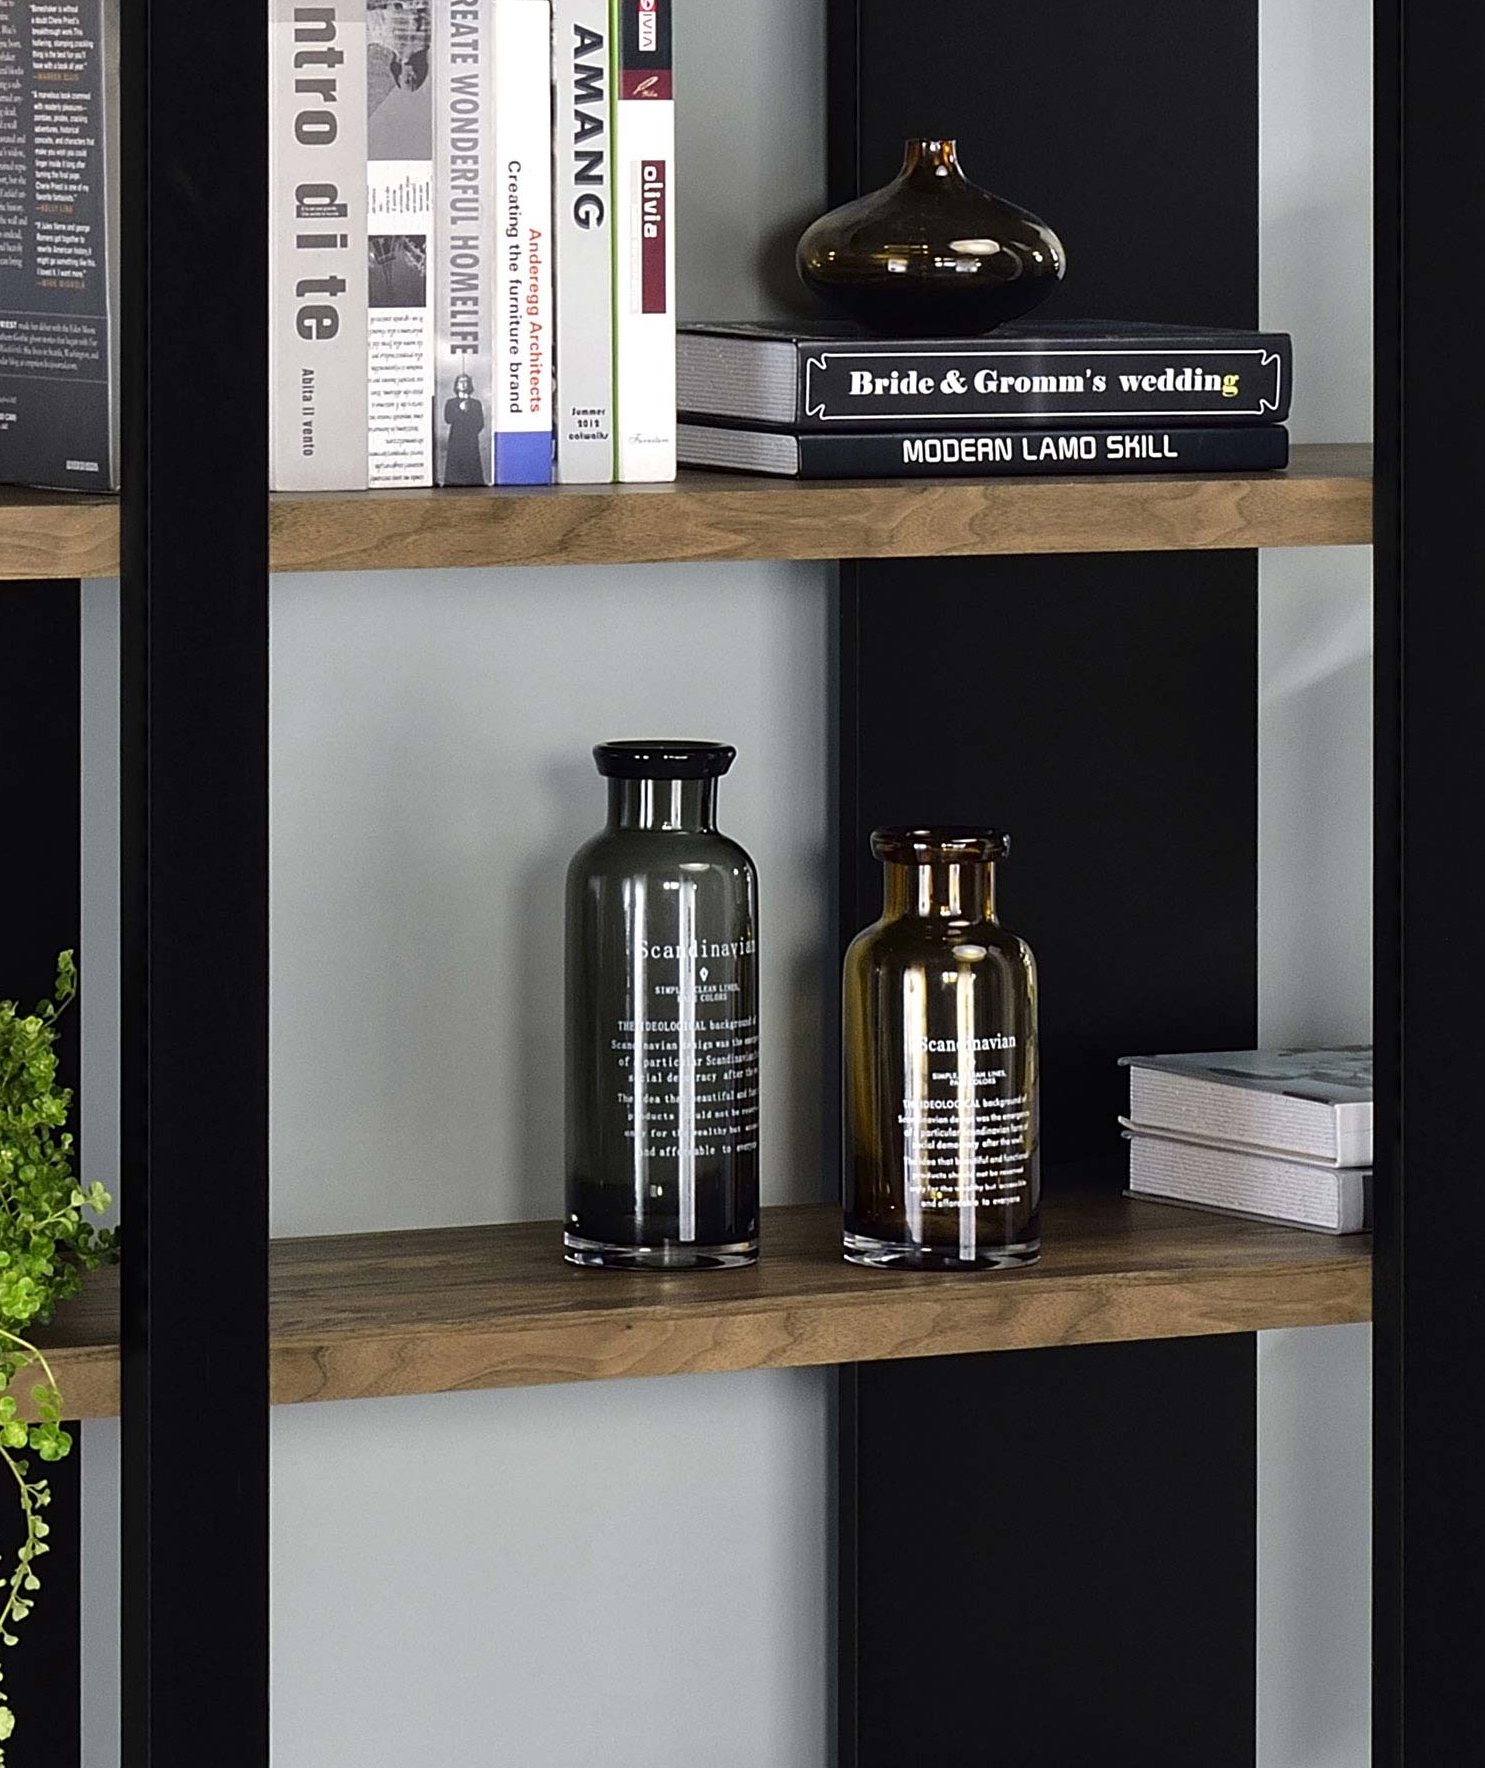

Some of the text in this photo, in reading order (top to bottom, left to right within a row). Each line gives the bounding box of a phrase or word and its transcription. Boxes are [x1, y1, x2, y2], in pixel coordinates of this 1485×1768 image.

[450, 74, 480, 225] WONDERFUL
[573, 23, 604, 230] AMANG
[295, 184, 348, 248] di
[643, 166, 663, 238] olivia
[296, 275, 346, 340] te
[450, 235, 480, 355] HOMELIFE
[506, 160, 522, 413] Creating the furniture brand
[526, 228, 543, 412] Anderegg Architects
[848, 368, 1240, 397] Bride & Gromm's wedding
[302, 419, 314, 456] vento
[902, 437, 1012, 464] MODERN
[1105, 434, 1178, 460] SKILL
